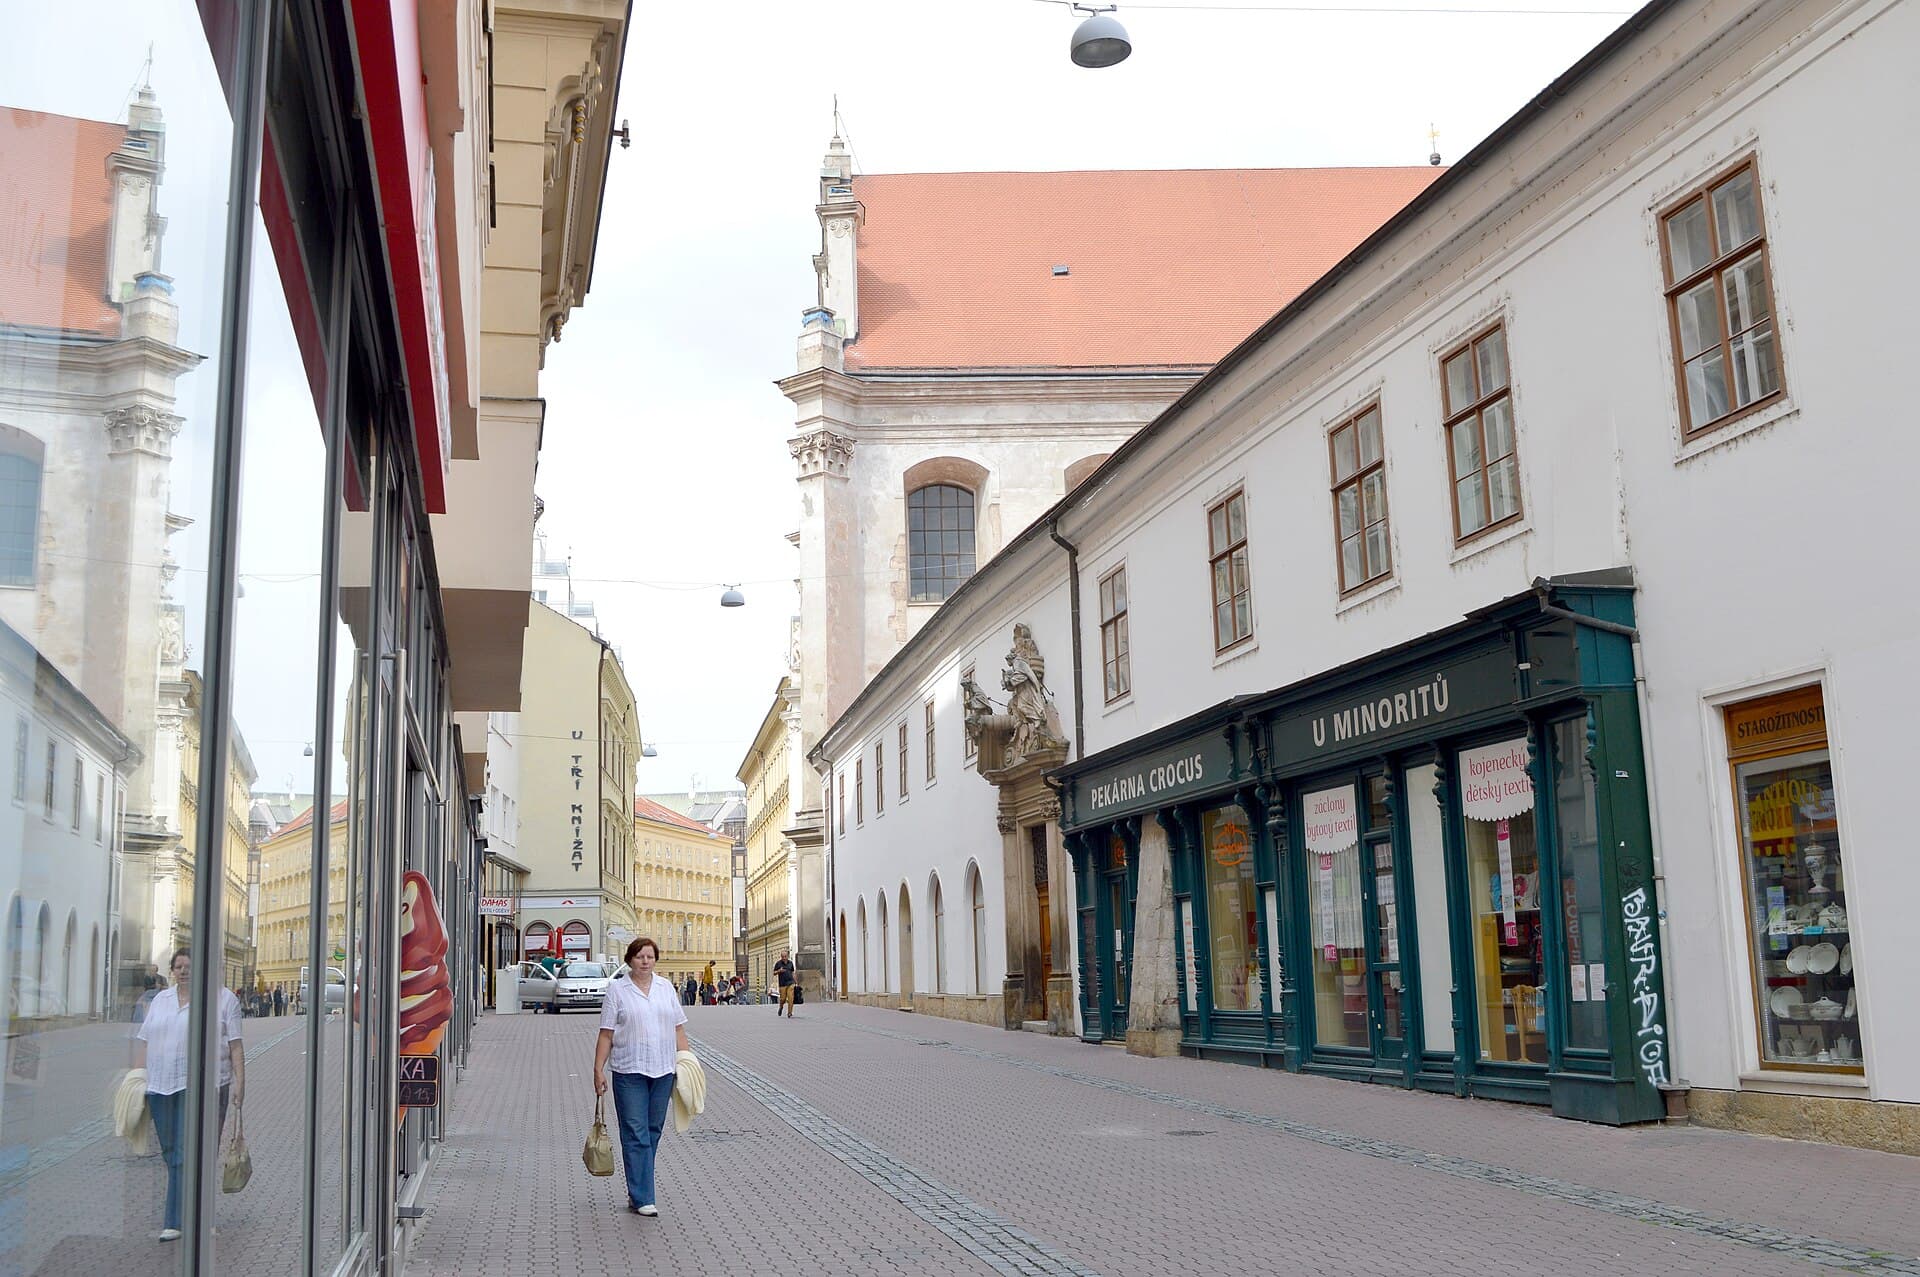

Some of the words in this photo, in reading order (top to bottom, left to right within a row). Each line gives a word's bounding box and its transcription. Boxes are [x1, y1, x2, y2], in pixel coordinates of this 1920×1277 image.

[1312, 717, 1326, 747] U
[1333, 672, 1449, 742] MINORITŮ
[571, 730, 583, 740] U
[571, 754, 584, 790] TŘÍ
[1468, 746, 1526, 778] kojenecký
[1091, 774, 1146, 810] PEKÁRNA
[1149, 753, 1203, 792] CROCUS
[1466, 778, 1502, 804] dětský
[1314, 795, 1346, 815] záclony
[1334, 812, 1356, 833] textil
[481, 899, 508, 907] DAMAS
